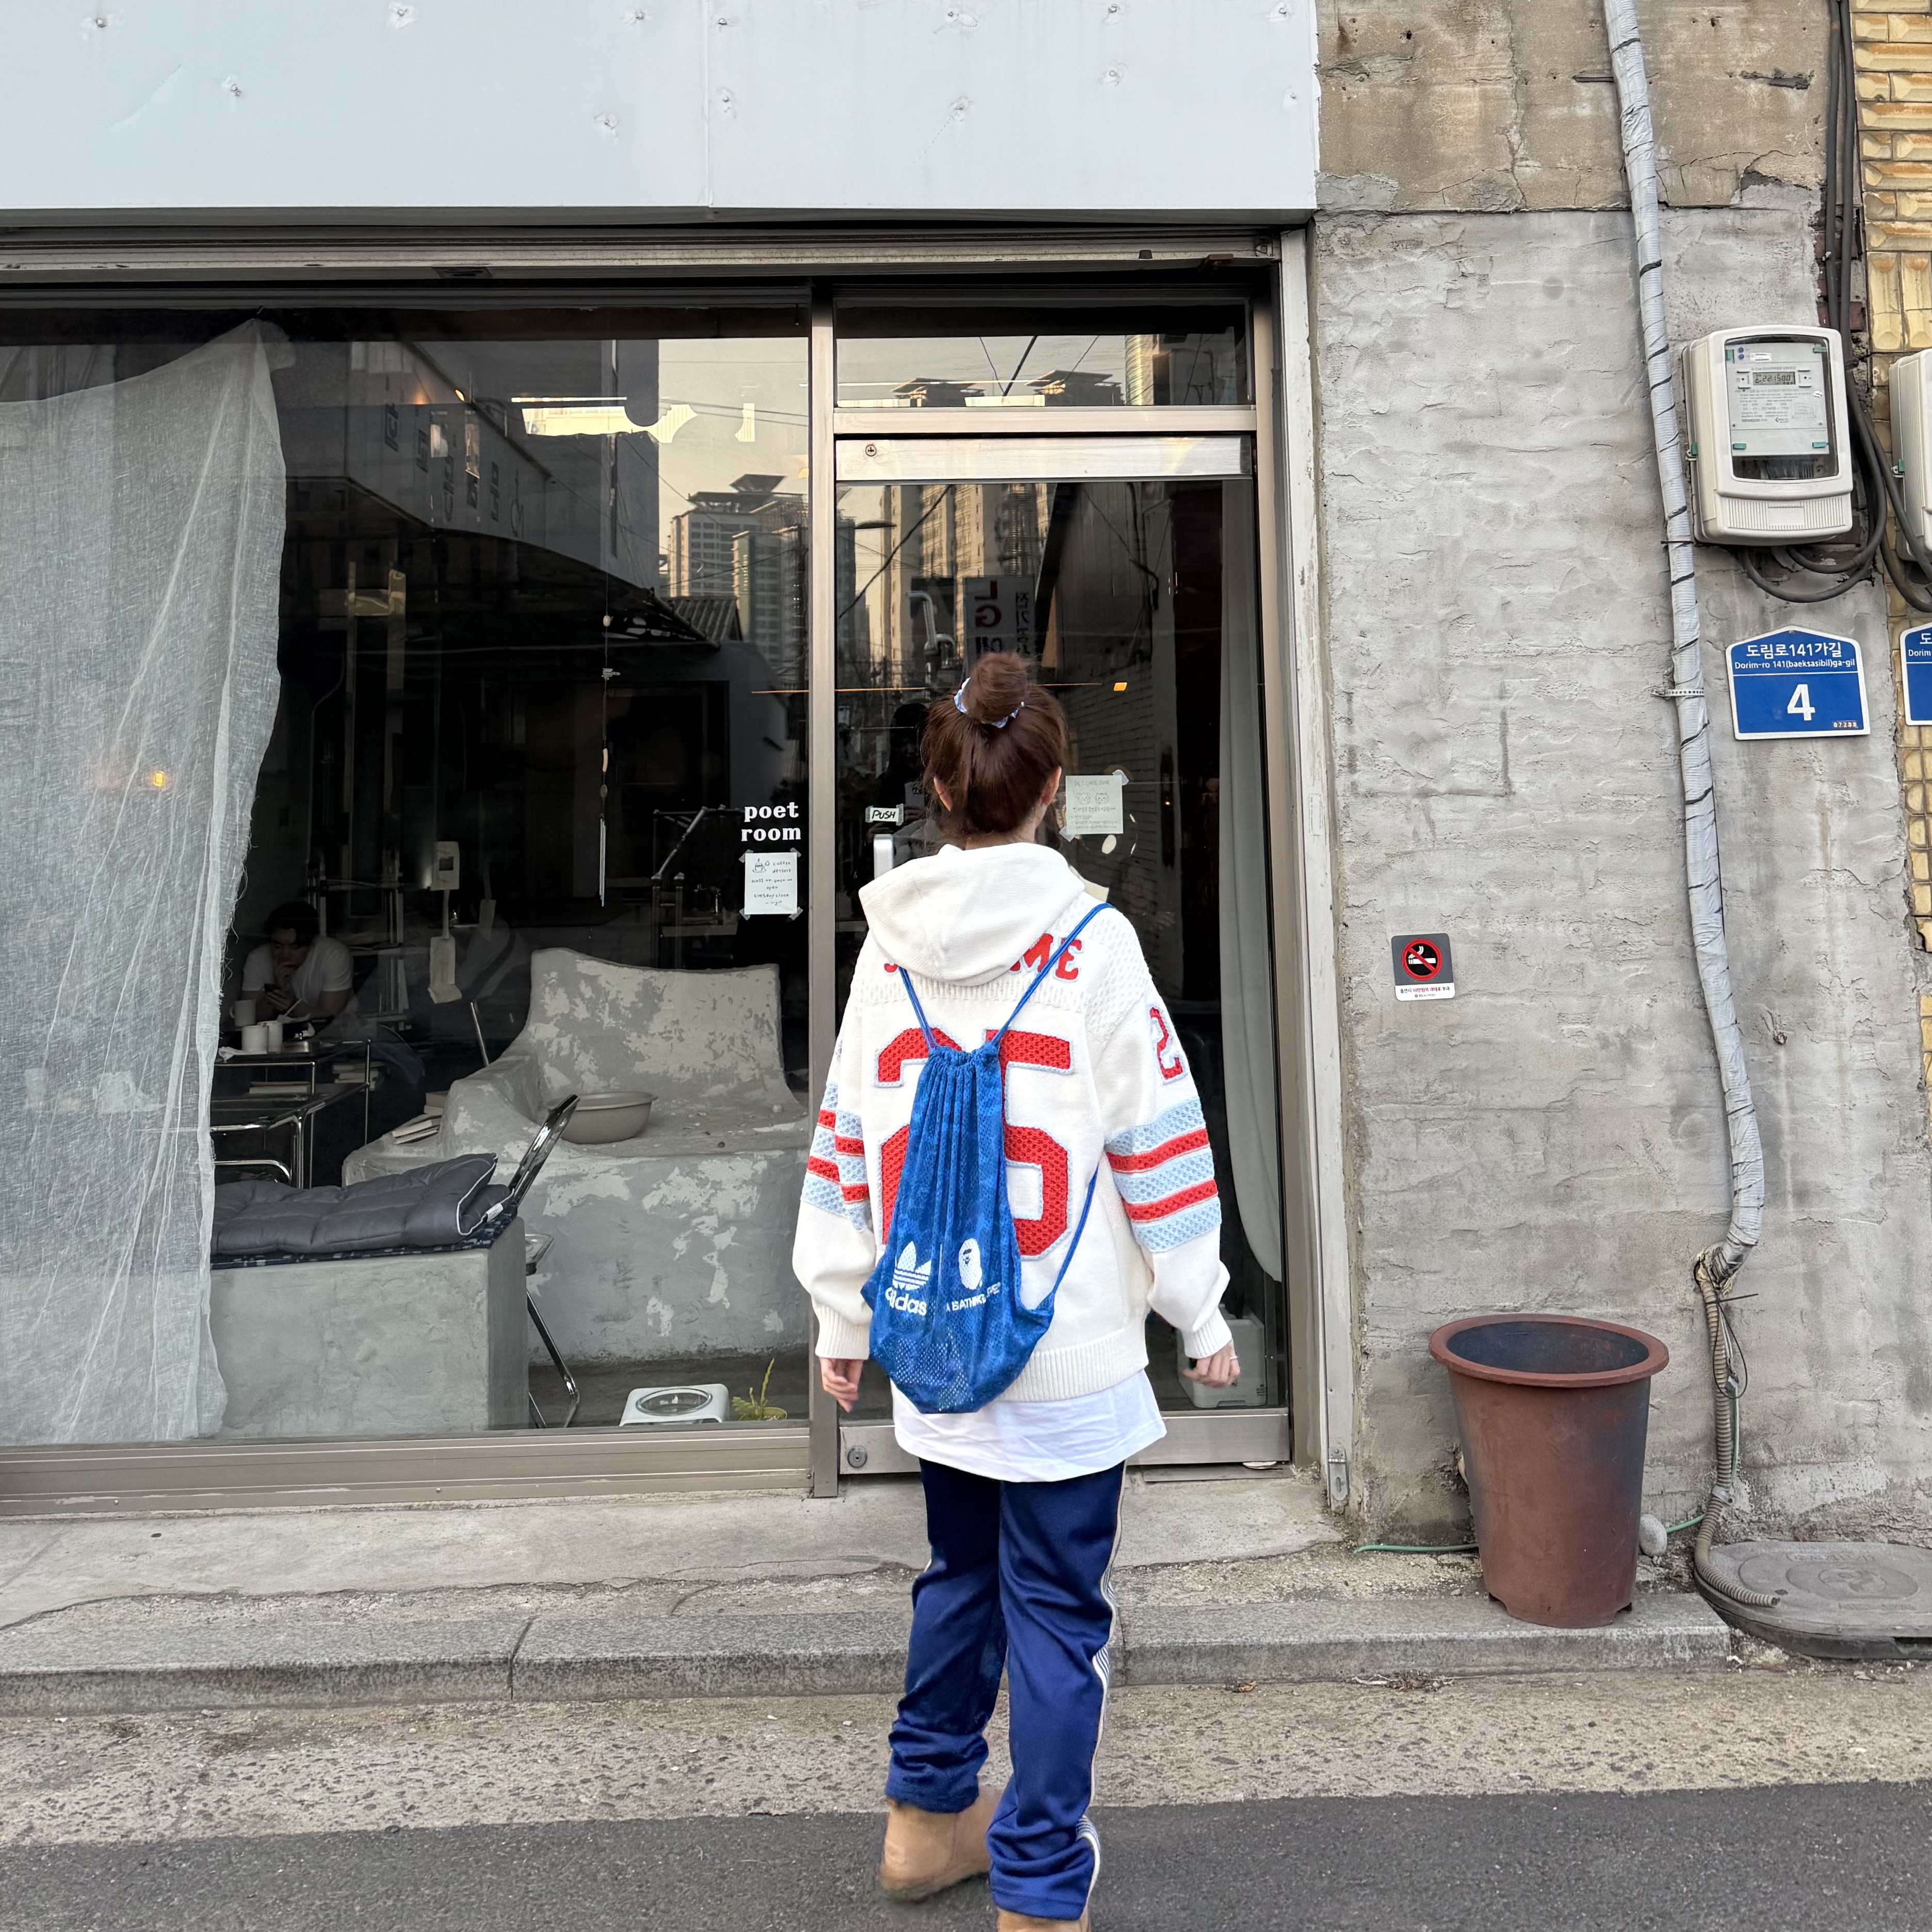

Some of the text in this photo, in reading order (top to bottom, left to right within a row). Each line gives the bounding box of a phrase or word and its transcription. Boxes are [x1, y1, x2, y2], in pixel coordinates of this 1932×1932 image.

[1746, 642, 1842, 659] 도림로141가길
[1734, 658, 1856, 669] Dorim-ro 141(baeksasibil)ga-gil
[1787, 684, 1815, 721] 4
[744, 802, 799, 822] poet
[872, 810, 896, 820] PUSH
[741, 827, 801, 842] room
[885, 1287, 927, 1316] aidas
